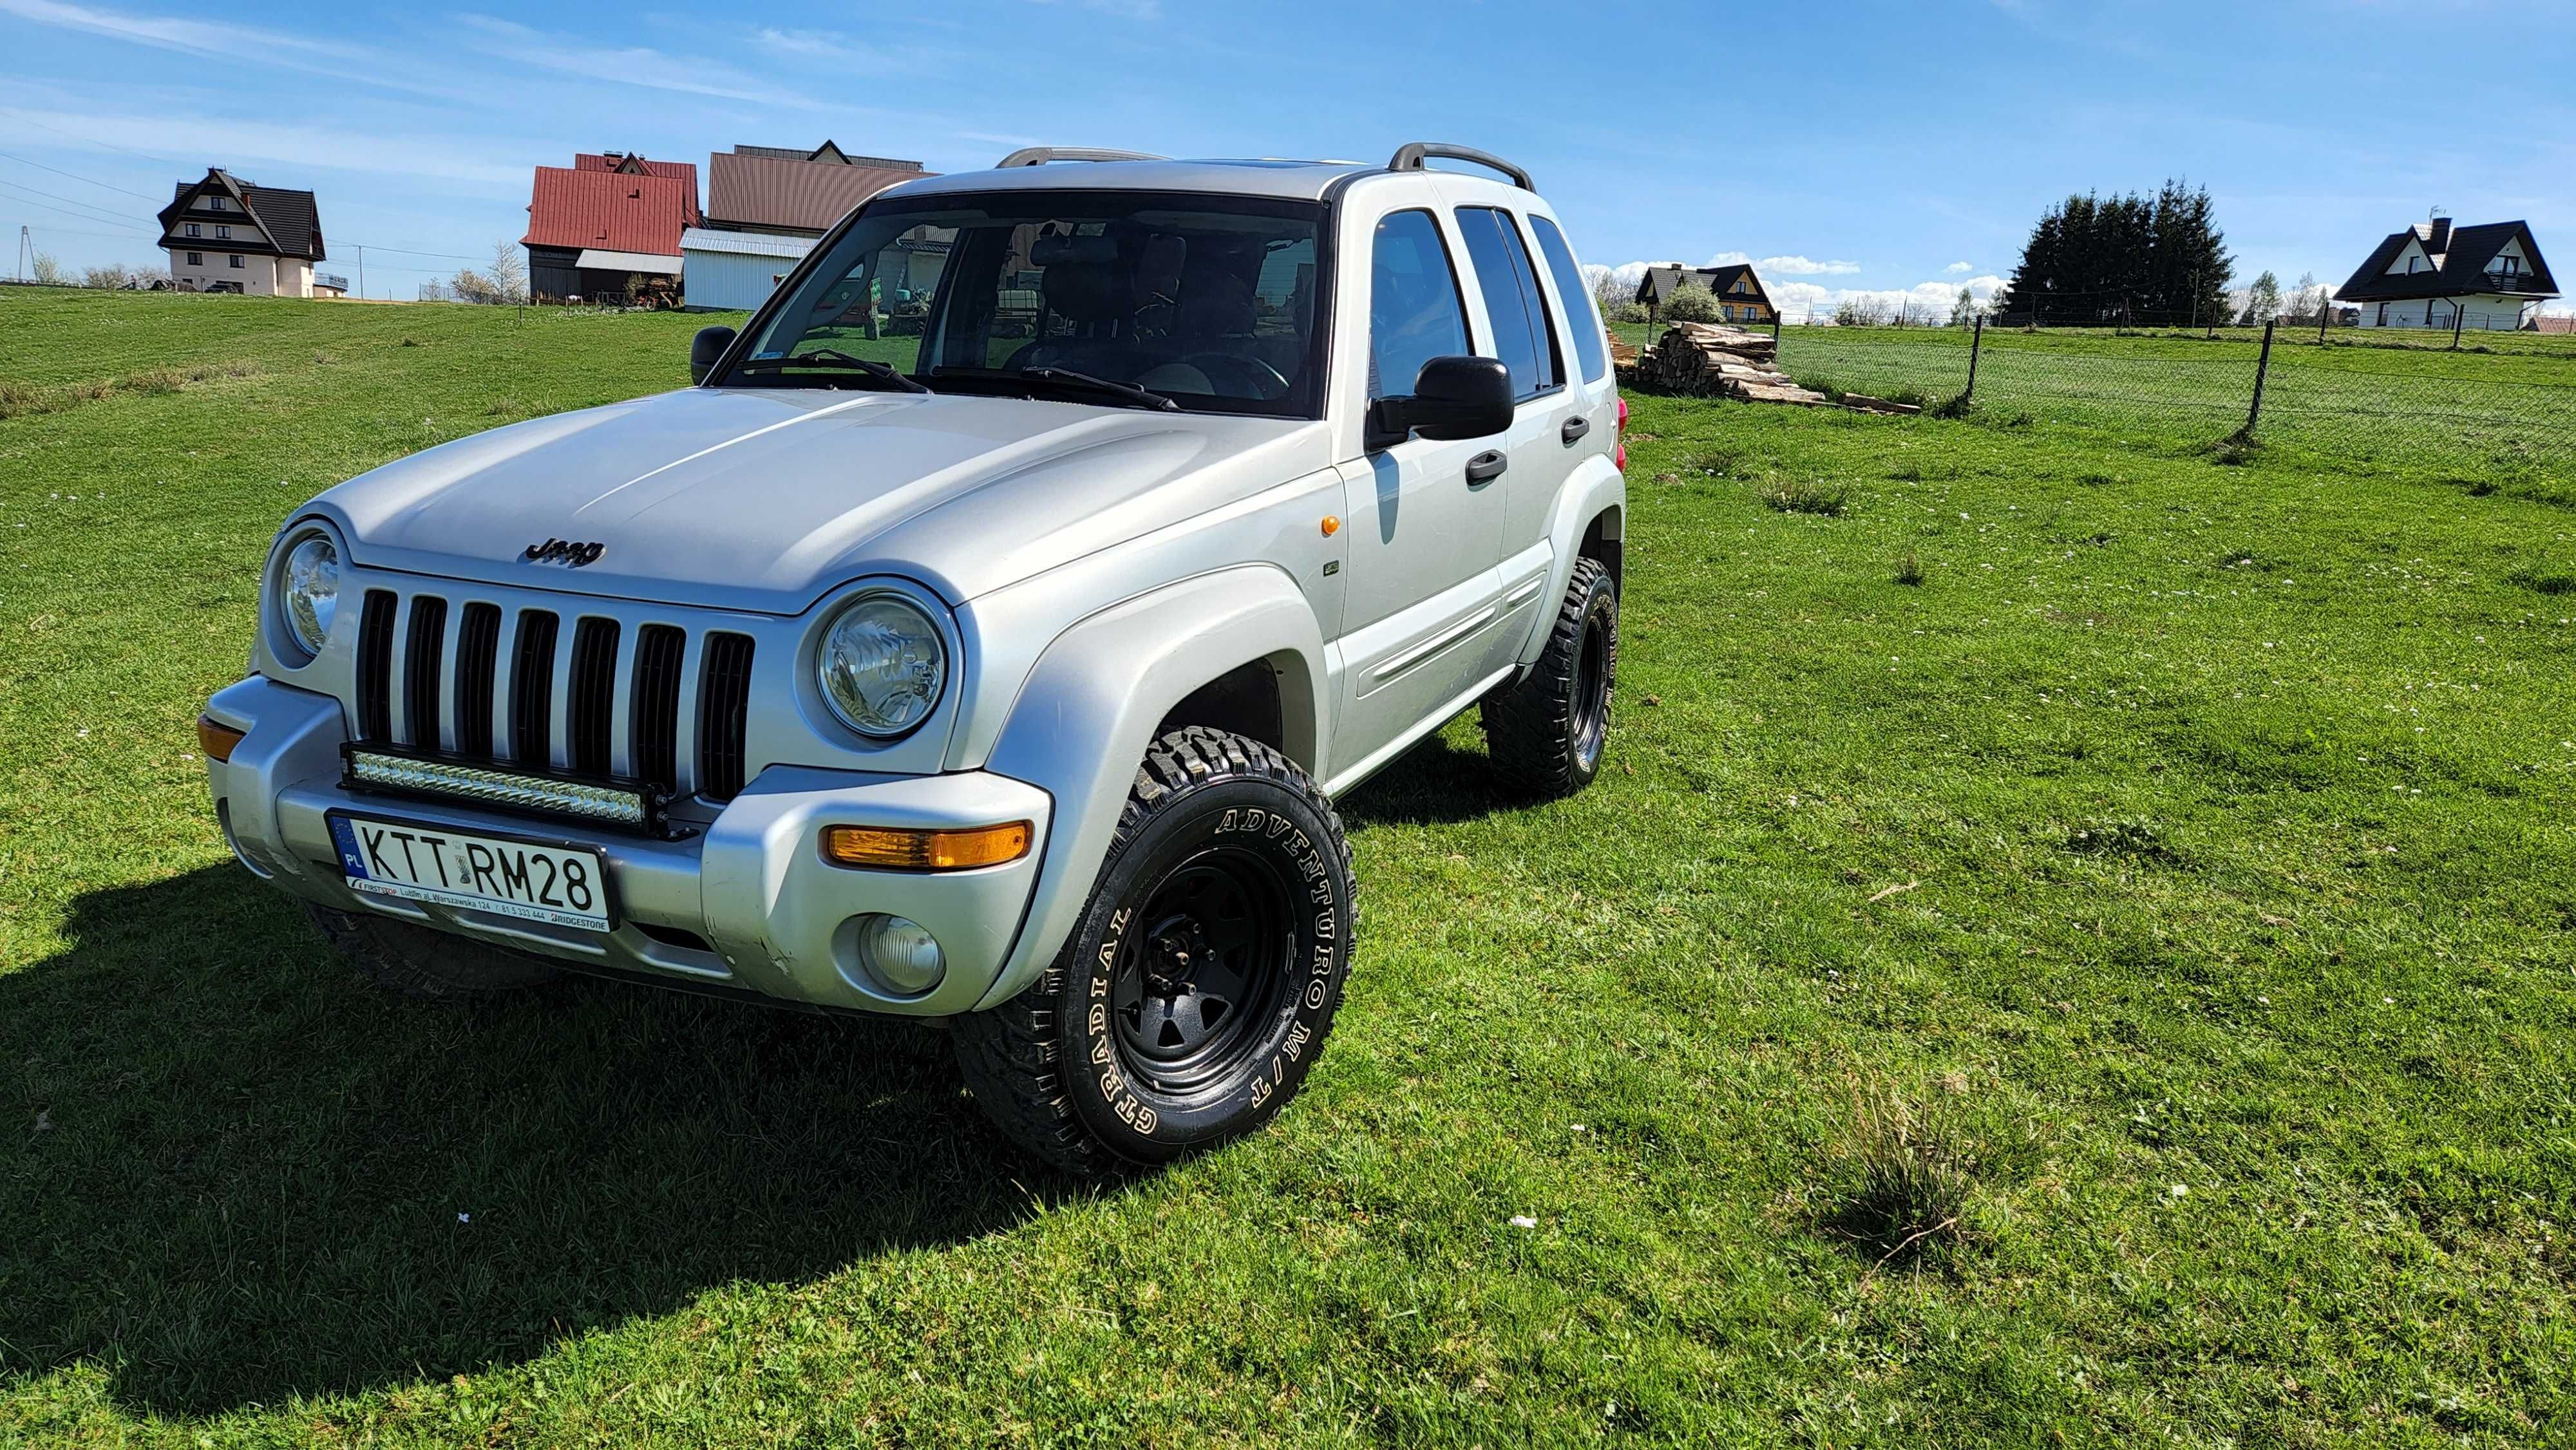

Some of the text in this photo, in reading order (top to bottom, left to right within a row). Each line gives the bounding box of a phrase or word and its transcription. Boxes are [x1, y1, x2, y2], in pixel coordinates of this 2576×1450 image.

[526, 537, 606, 565] Jeep
[345, 854, 363, 868] PL
[361, 827, 592, 911] KTT RM28
[478, 901, 490, 910] 124
[551, 913, 606, 929] BRIDGESTONE
[1215, 809, 1335, 1109] ADVENTURO M/T
